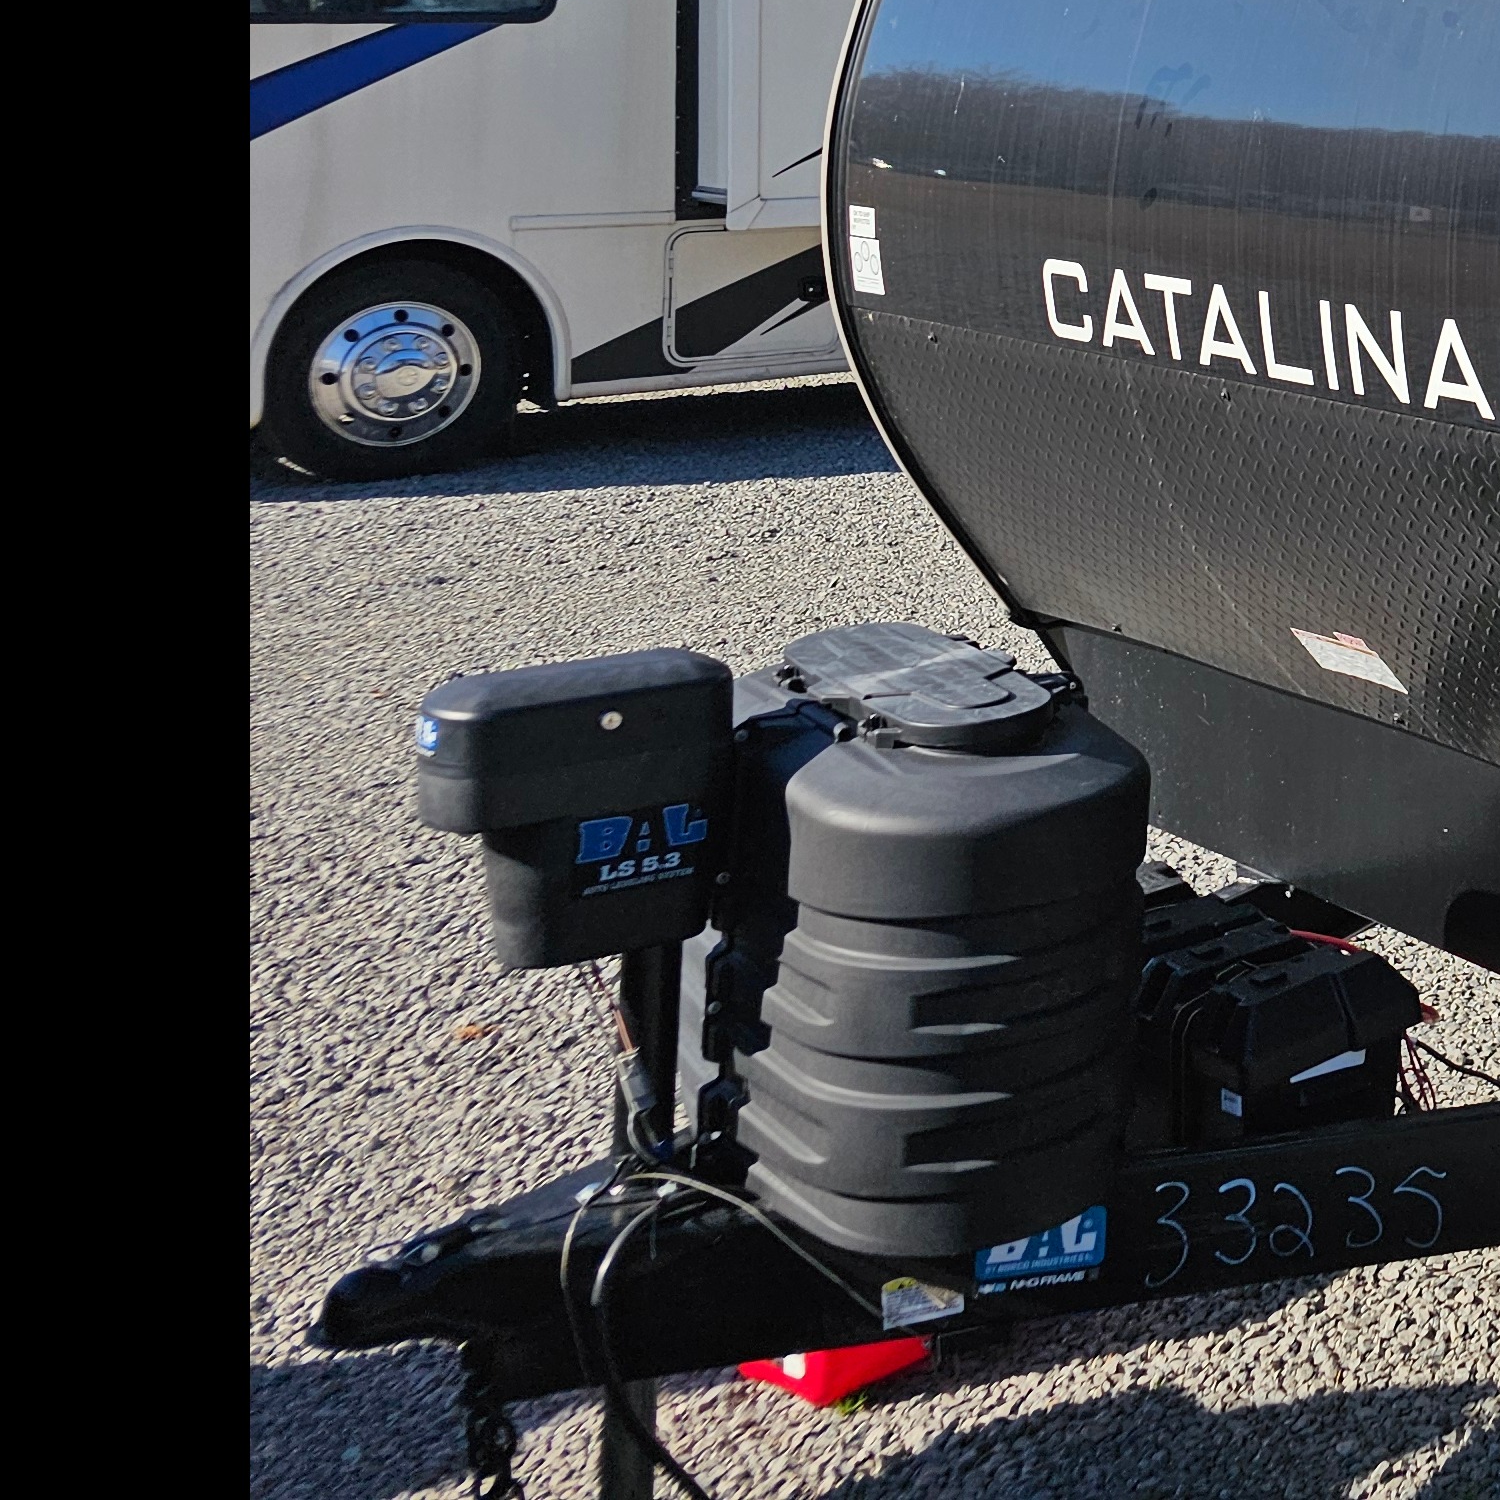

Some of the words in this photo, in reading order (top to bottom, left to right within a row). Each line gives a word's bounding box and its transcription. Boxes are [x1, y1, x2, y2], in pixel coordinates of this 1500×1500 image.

[1042, 258, 1496, 421] CATALINA
[599, 859, 637, 882] LS
[641, 851, 682, 873] 5.3
[1145, 1165, 1447, 1290] 33235
